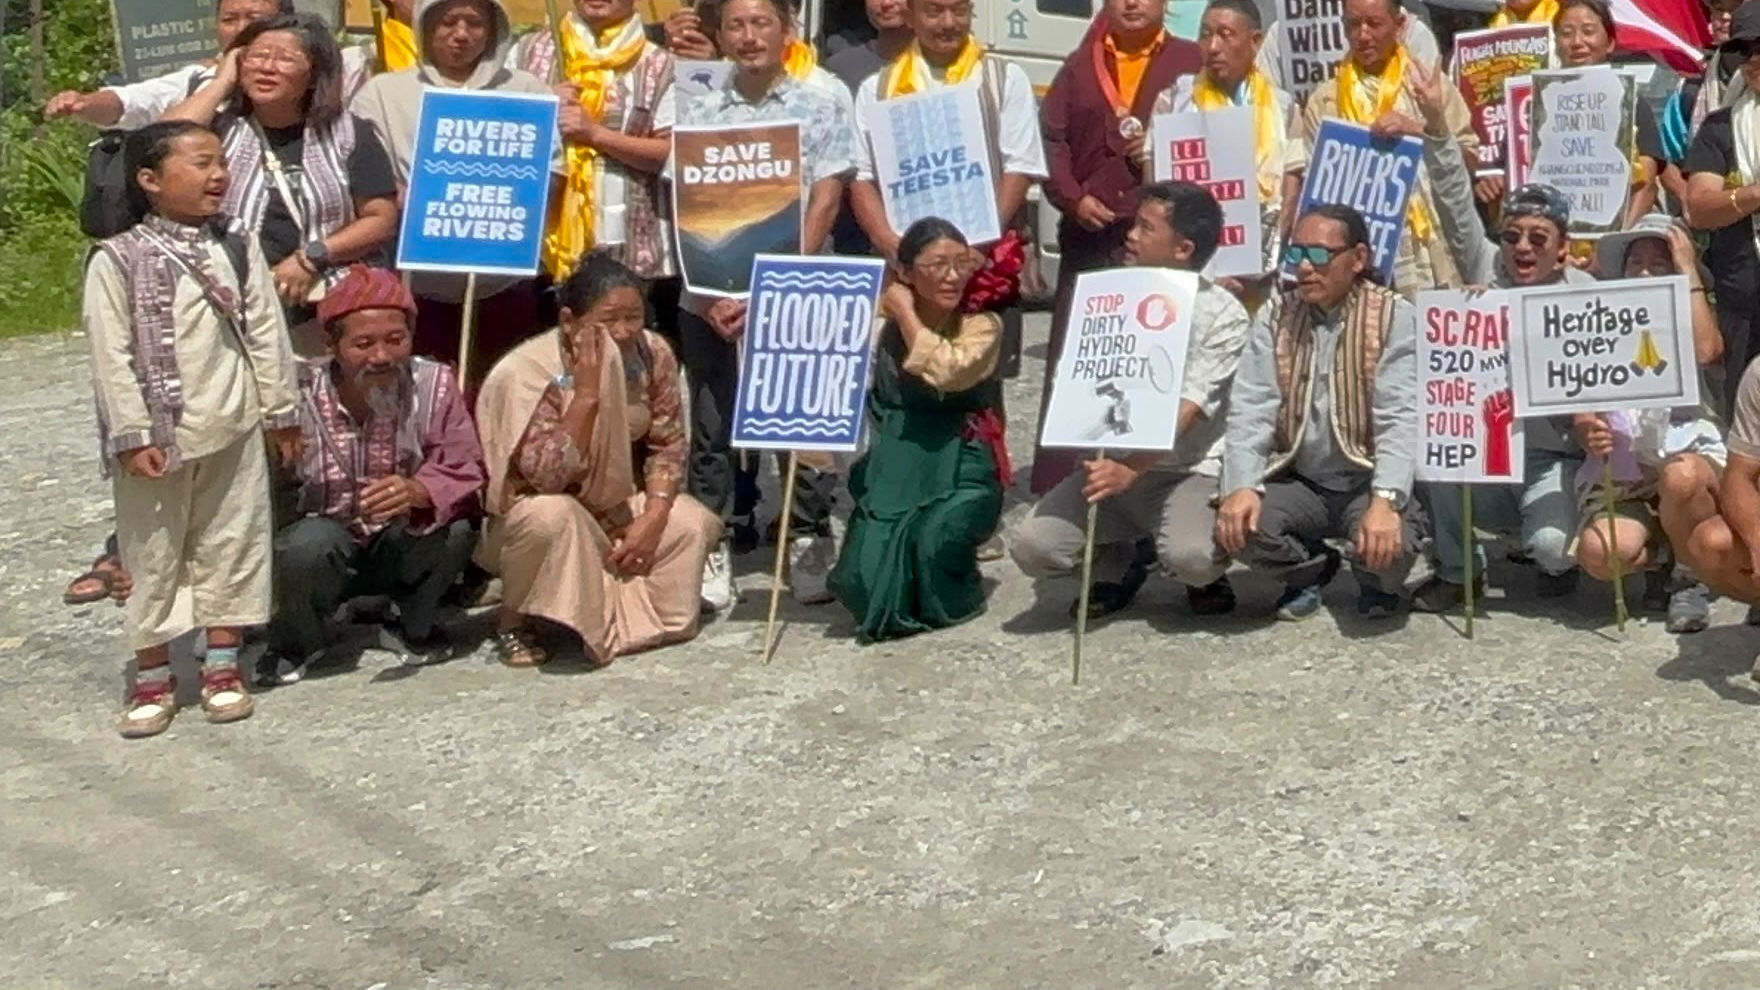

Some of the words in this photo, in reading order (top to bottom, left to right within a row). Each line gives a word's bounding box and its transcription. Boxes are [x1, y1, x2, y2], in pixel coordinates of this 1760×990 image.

[131, 19, 194, 40] PLASTIC
[1287, 21, 1343, 53] Will
[436, 117, 537, 142] RIVERS
[433, 138, 483, 155] FOR
[487, 141, 535, 159] LIFE
[704, 142, 772, 165] SAVE
[1560, 137, 1596, 158] SAVE
[683, 160, 793, 185] DZONGU
[898, 145, 967, 178] SAVE
[887, 161, 985, 199] TEESTA
[445, 182, 514, 205] FREE
[426, 201, 527, 221] FLOWING
[423, 217, 525, 242] RIVERS
[1084, 293, 1126, 316] STOP
[1543, 296, 1651, 338] Heritage
[754, 291, 872, 353] FLOODED
[1081, 314, 1128, 337] DIRTY
[1077, 334, 1137, 359] HYDRO
[1563, 335, 1620, 358] over
[1072, 356, 1149, 380] PROJECT
[1429, 350, 1474, 374] 520
[746, 352, 862, 417] FUTURE
[1548, 360, 1630, 397] Hydro
[1426, 376, 1476, 407] STAGE
[1426, 411, 1475, 439] FOUR
[1426, 442, 1477, 469] HEP
